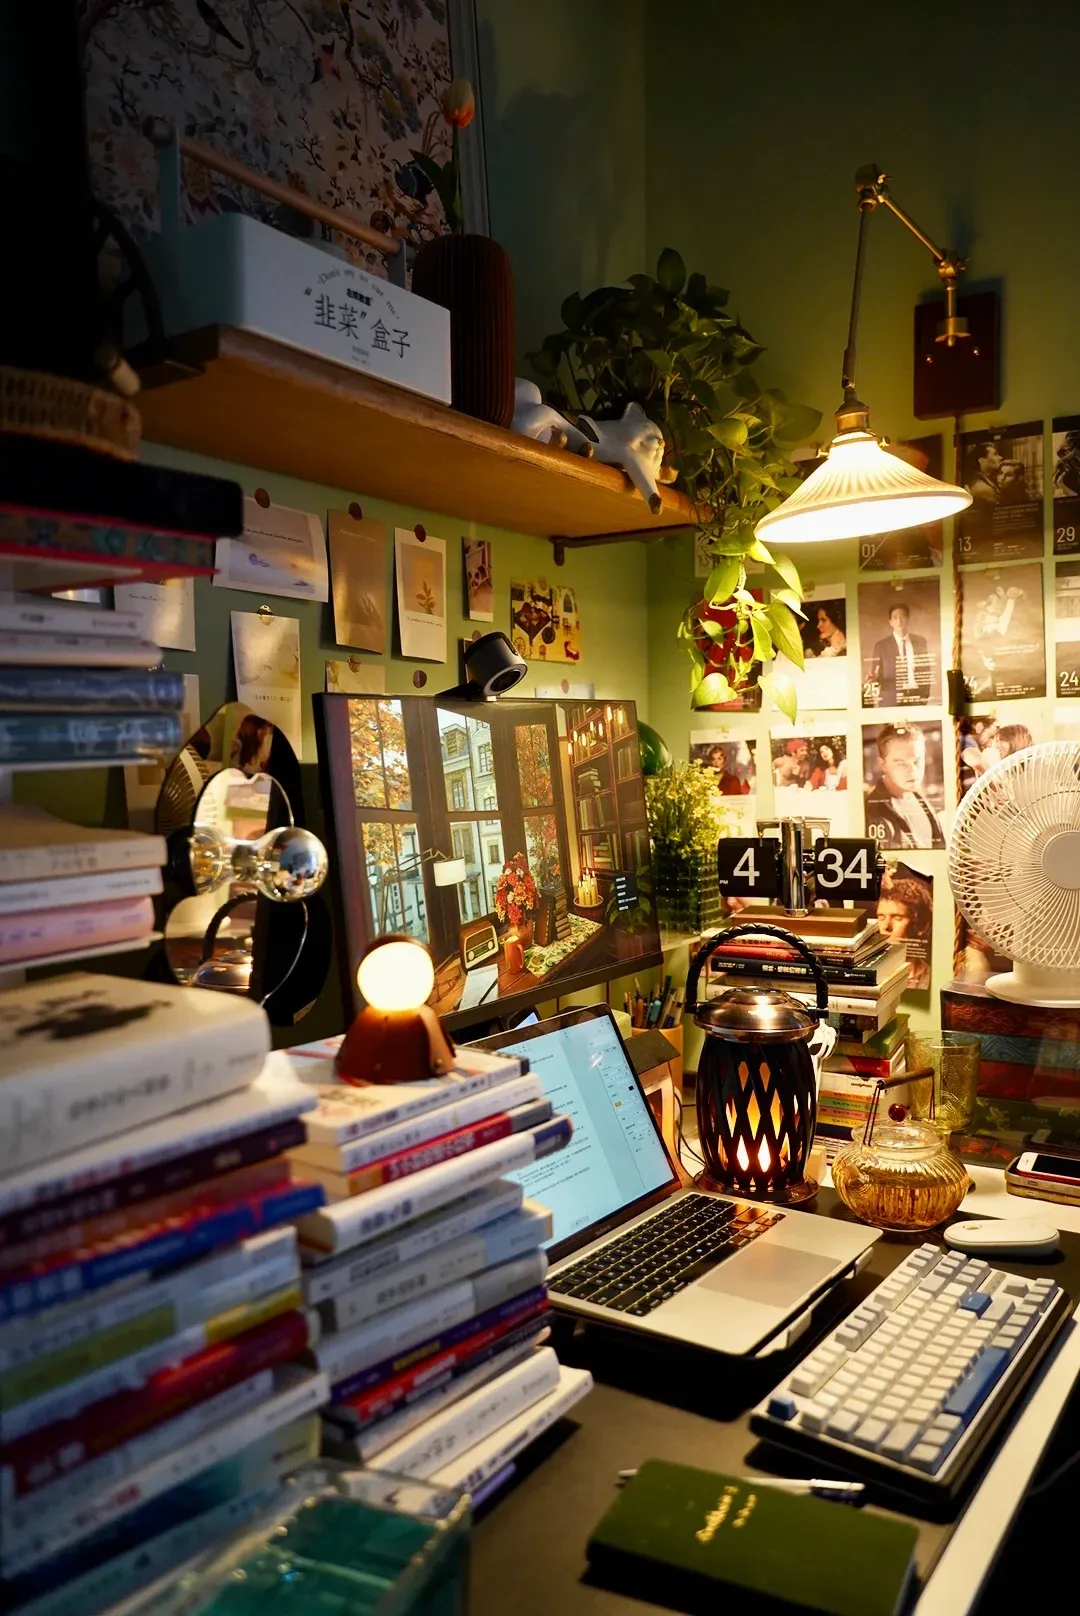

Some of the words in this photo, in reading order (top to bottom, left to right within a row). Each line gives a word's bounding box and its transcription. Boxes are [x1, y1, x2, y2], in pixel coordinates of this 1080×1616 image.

[1057, 526, 1075, 543] 29
[861, 543, 876, 558] 01
[957, 536, 972, 553] 13
[1060, 671, 1079, 687] 24
[864, 682, 880, 698] 25
[868, 823, 886, 839] 06
[732, 847, 761, 886] 4
[817, 847, 873, 889] 34
